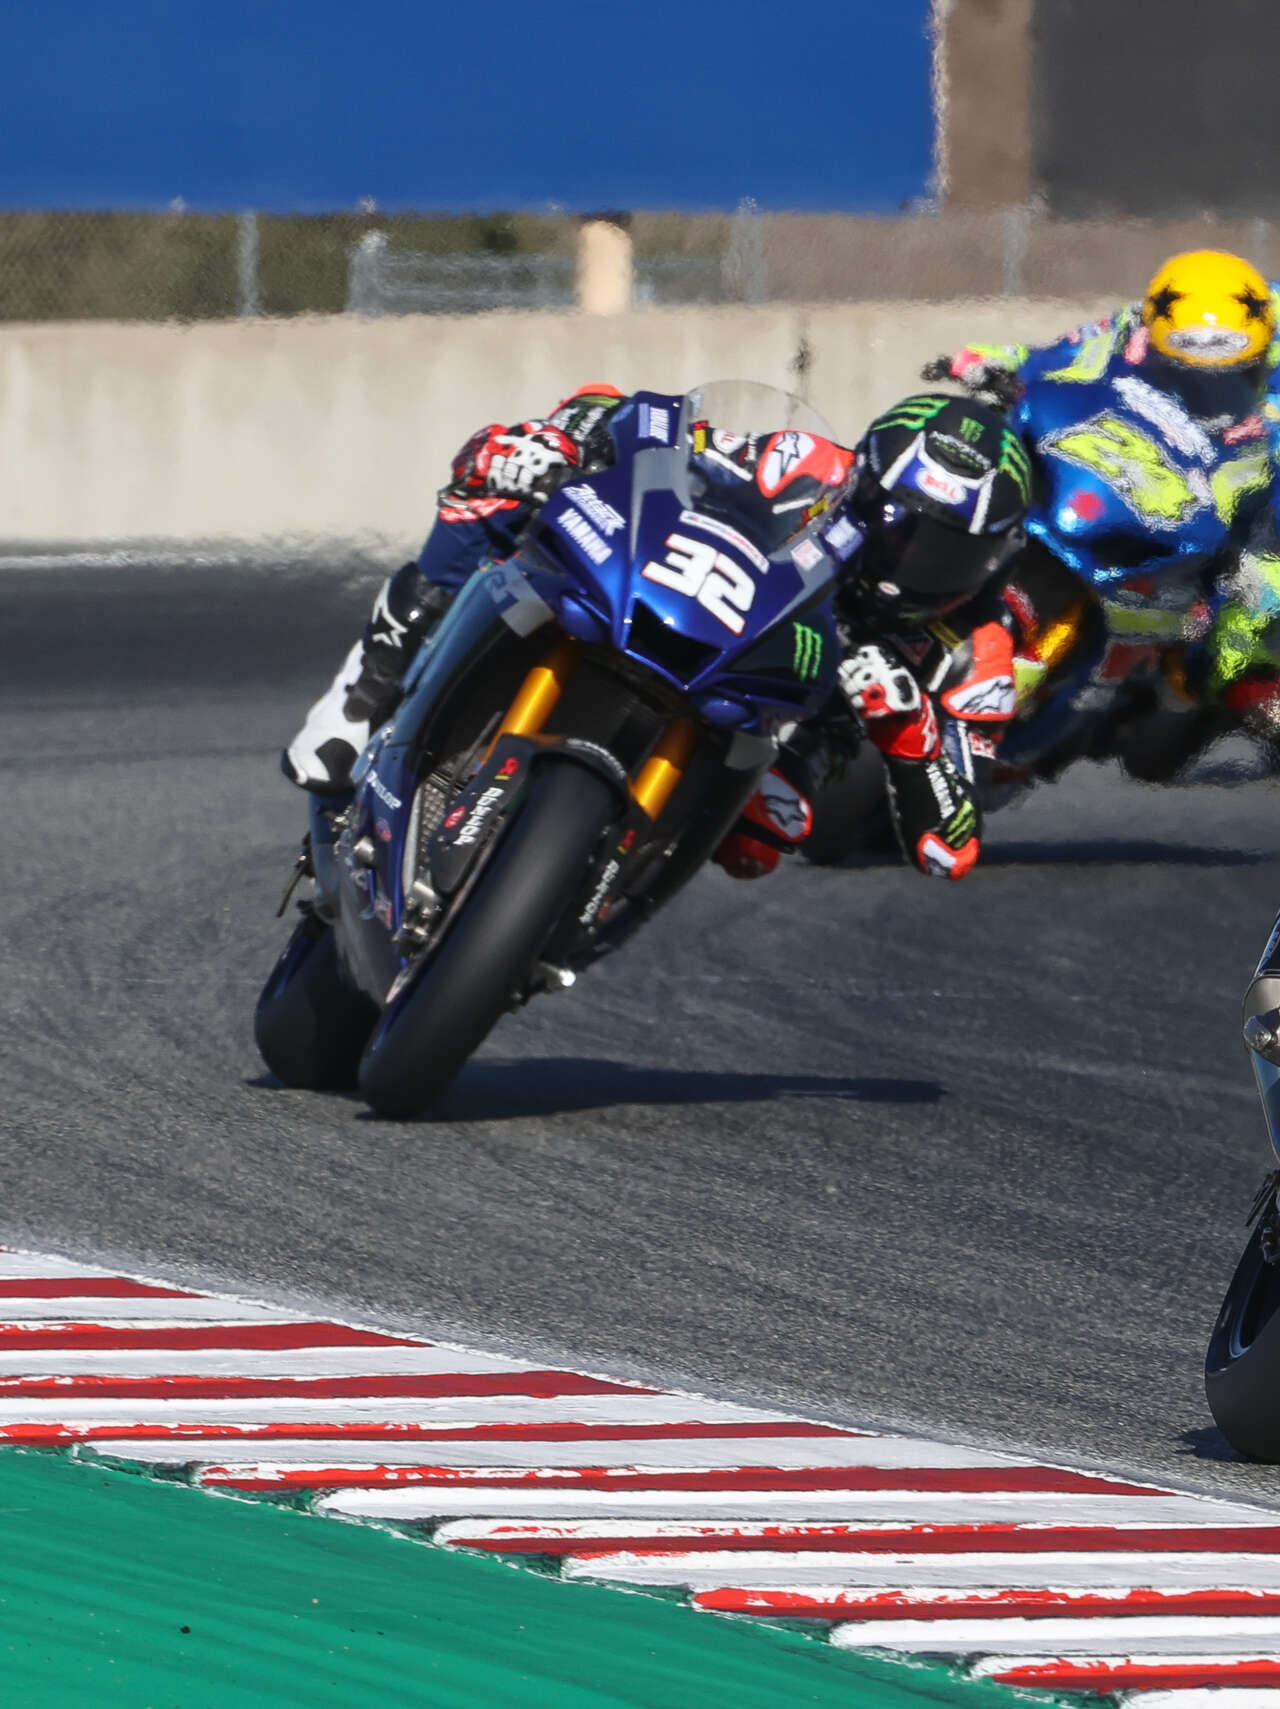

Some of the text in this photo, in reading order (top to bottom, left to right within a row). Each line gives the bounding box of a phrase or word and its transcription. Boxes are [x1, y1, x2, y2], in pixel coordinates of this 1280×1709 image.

[558, 507, 613, 565] YAMAHA
[641, 532, 756, 636] 32
[453, 787, 504, 846] DUNLOP
